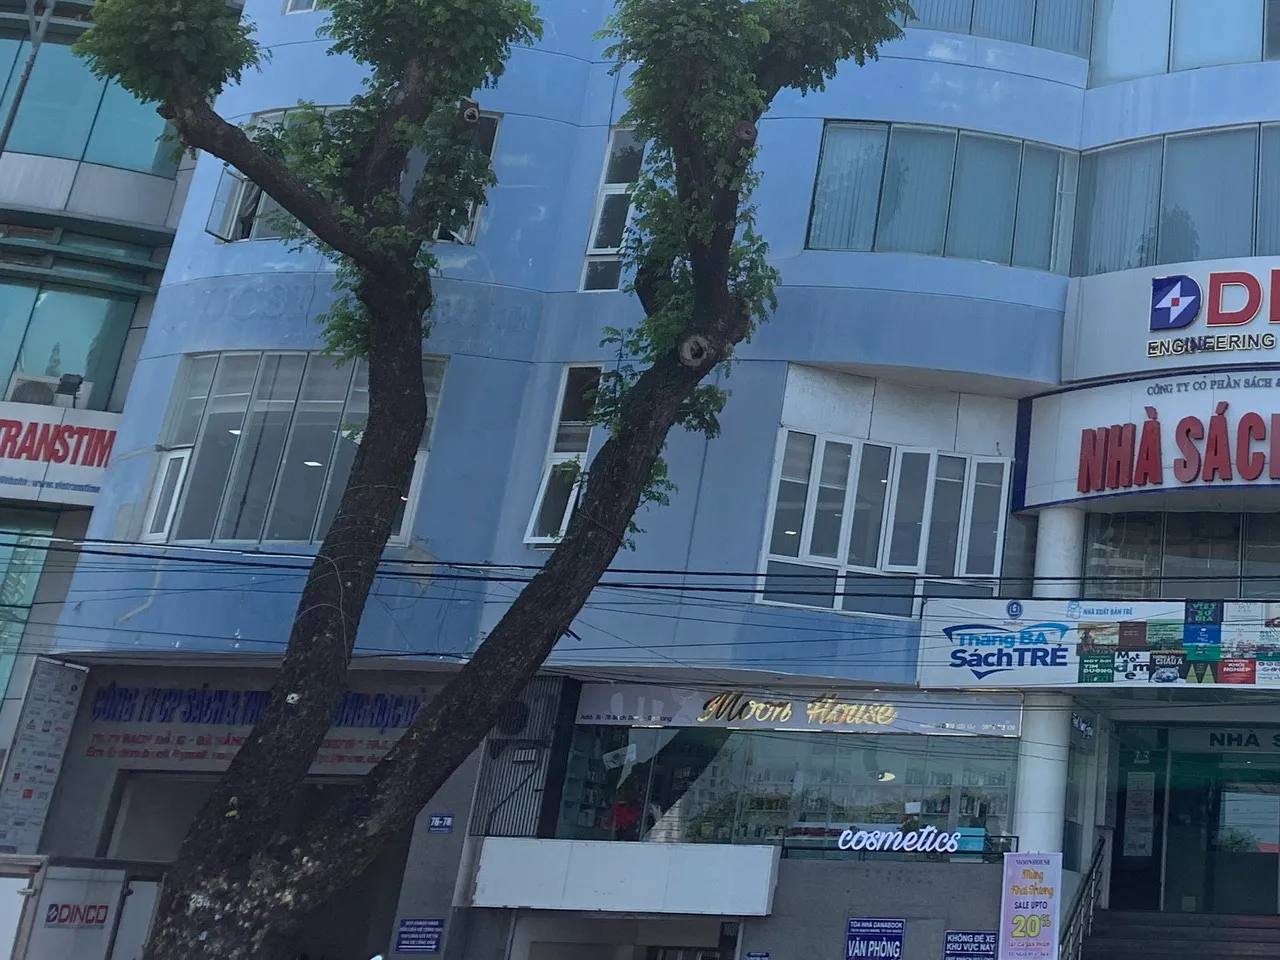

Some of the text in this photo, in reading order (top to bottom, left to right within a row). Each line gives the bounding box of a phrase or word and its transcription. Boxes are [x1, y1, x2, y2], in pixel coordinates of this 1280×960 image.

[1147, 333, 1276, 357] ENGINEERING
[1146, 383, 1174, 396] CÔNG
[1176, 382, 1190, 393] TY
[1243, 376, 1273, 389] SÁCH
[1077, 406, 1164, 493] NHÀ
[955, 632, 1016, 649] Tháng
[695, 691, 899, 726] Moon House
[1208, 729, 1261, 748] NHÀ
[838, 824, 962, 852] cosmetics
[57, 904, 109, 924] DINCO
[1014, 901, 1030, 910] SALE
[848, 936, 901, 958] VĂN PHÒNG
[946, 943, 962, 951] KHU
[963, 943, 979, 952] VỰC
[947, 933, 973, 943] KHÔNG
[985, 935, 996, 943] XE
